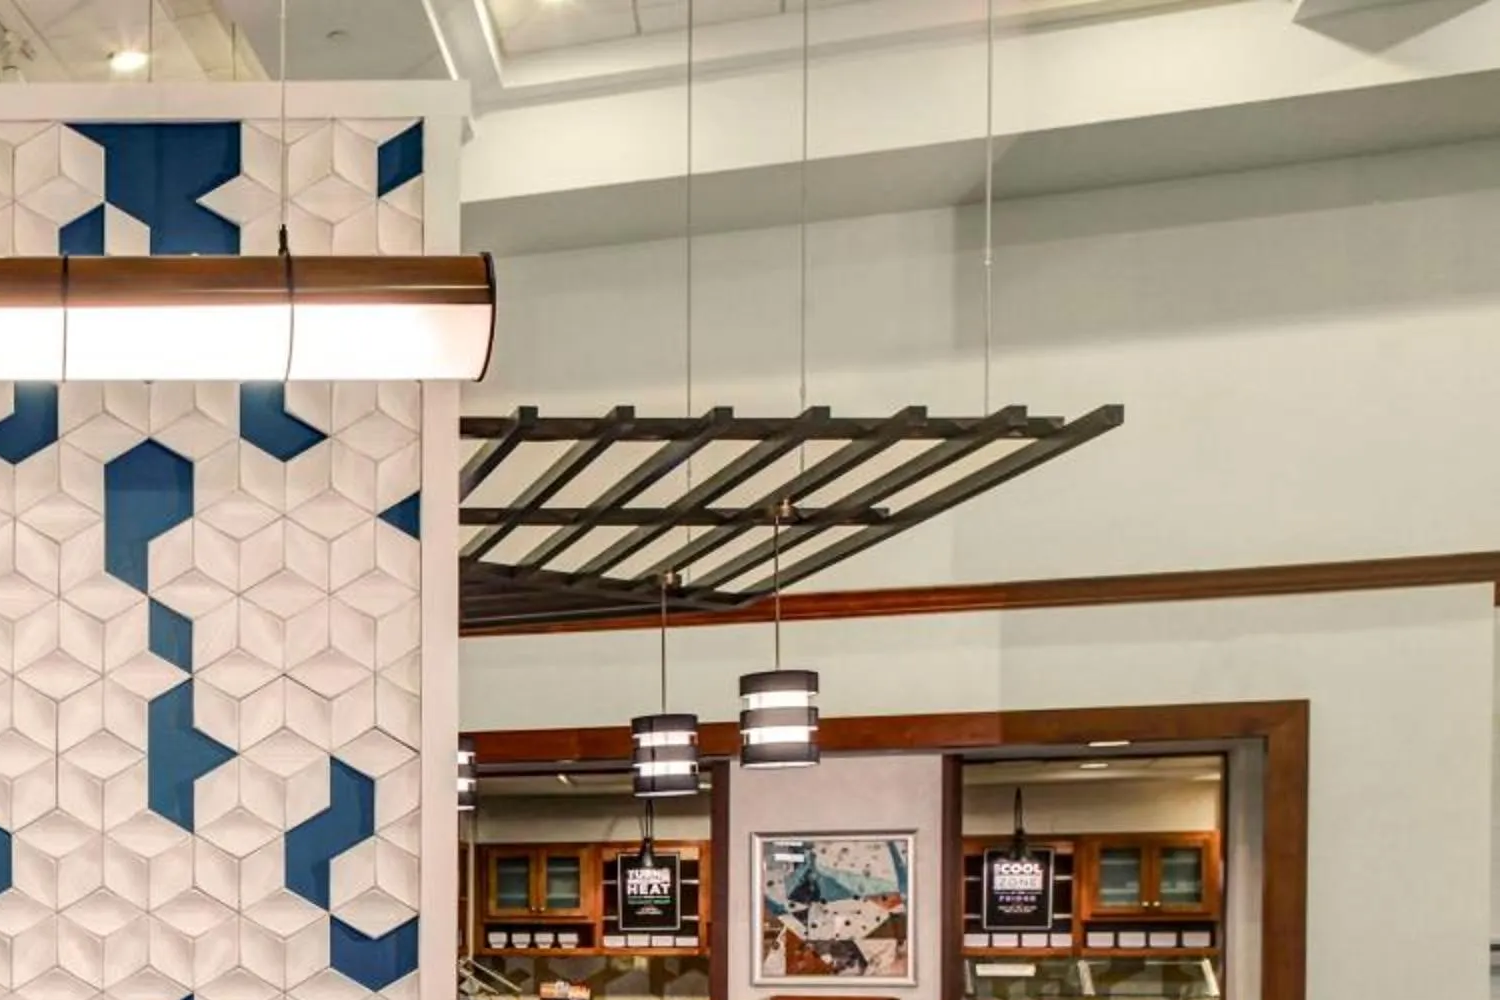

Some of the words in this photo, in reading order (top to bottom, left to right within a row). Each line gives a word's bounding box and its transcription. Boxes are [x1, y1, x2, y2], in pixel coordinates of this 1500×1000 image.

[1001, 863, 1044, 873] COOL
[627, 882, 670, 895] HEAT
[998, 876, 1040, 889] ZONE
